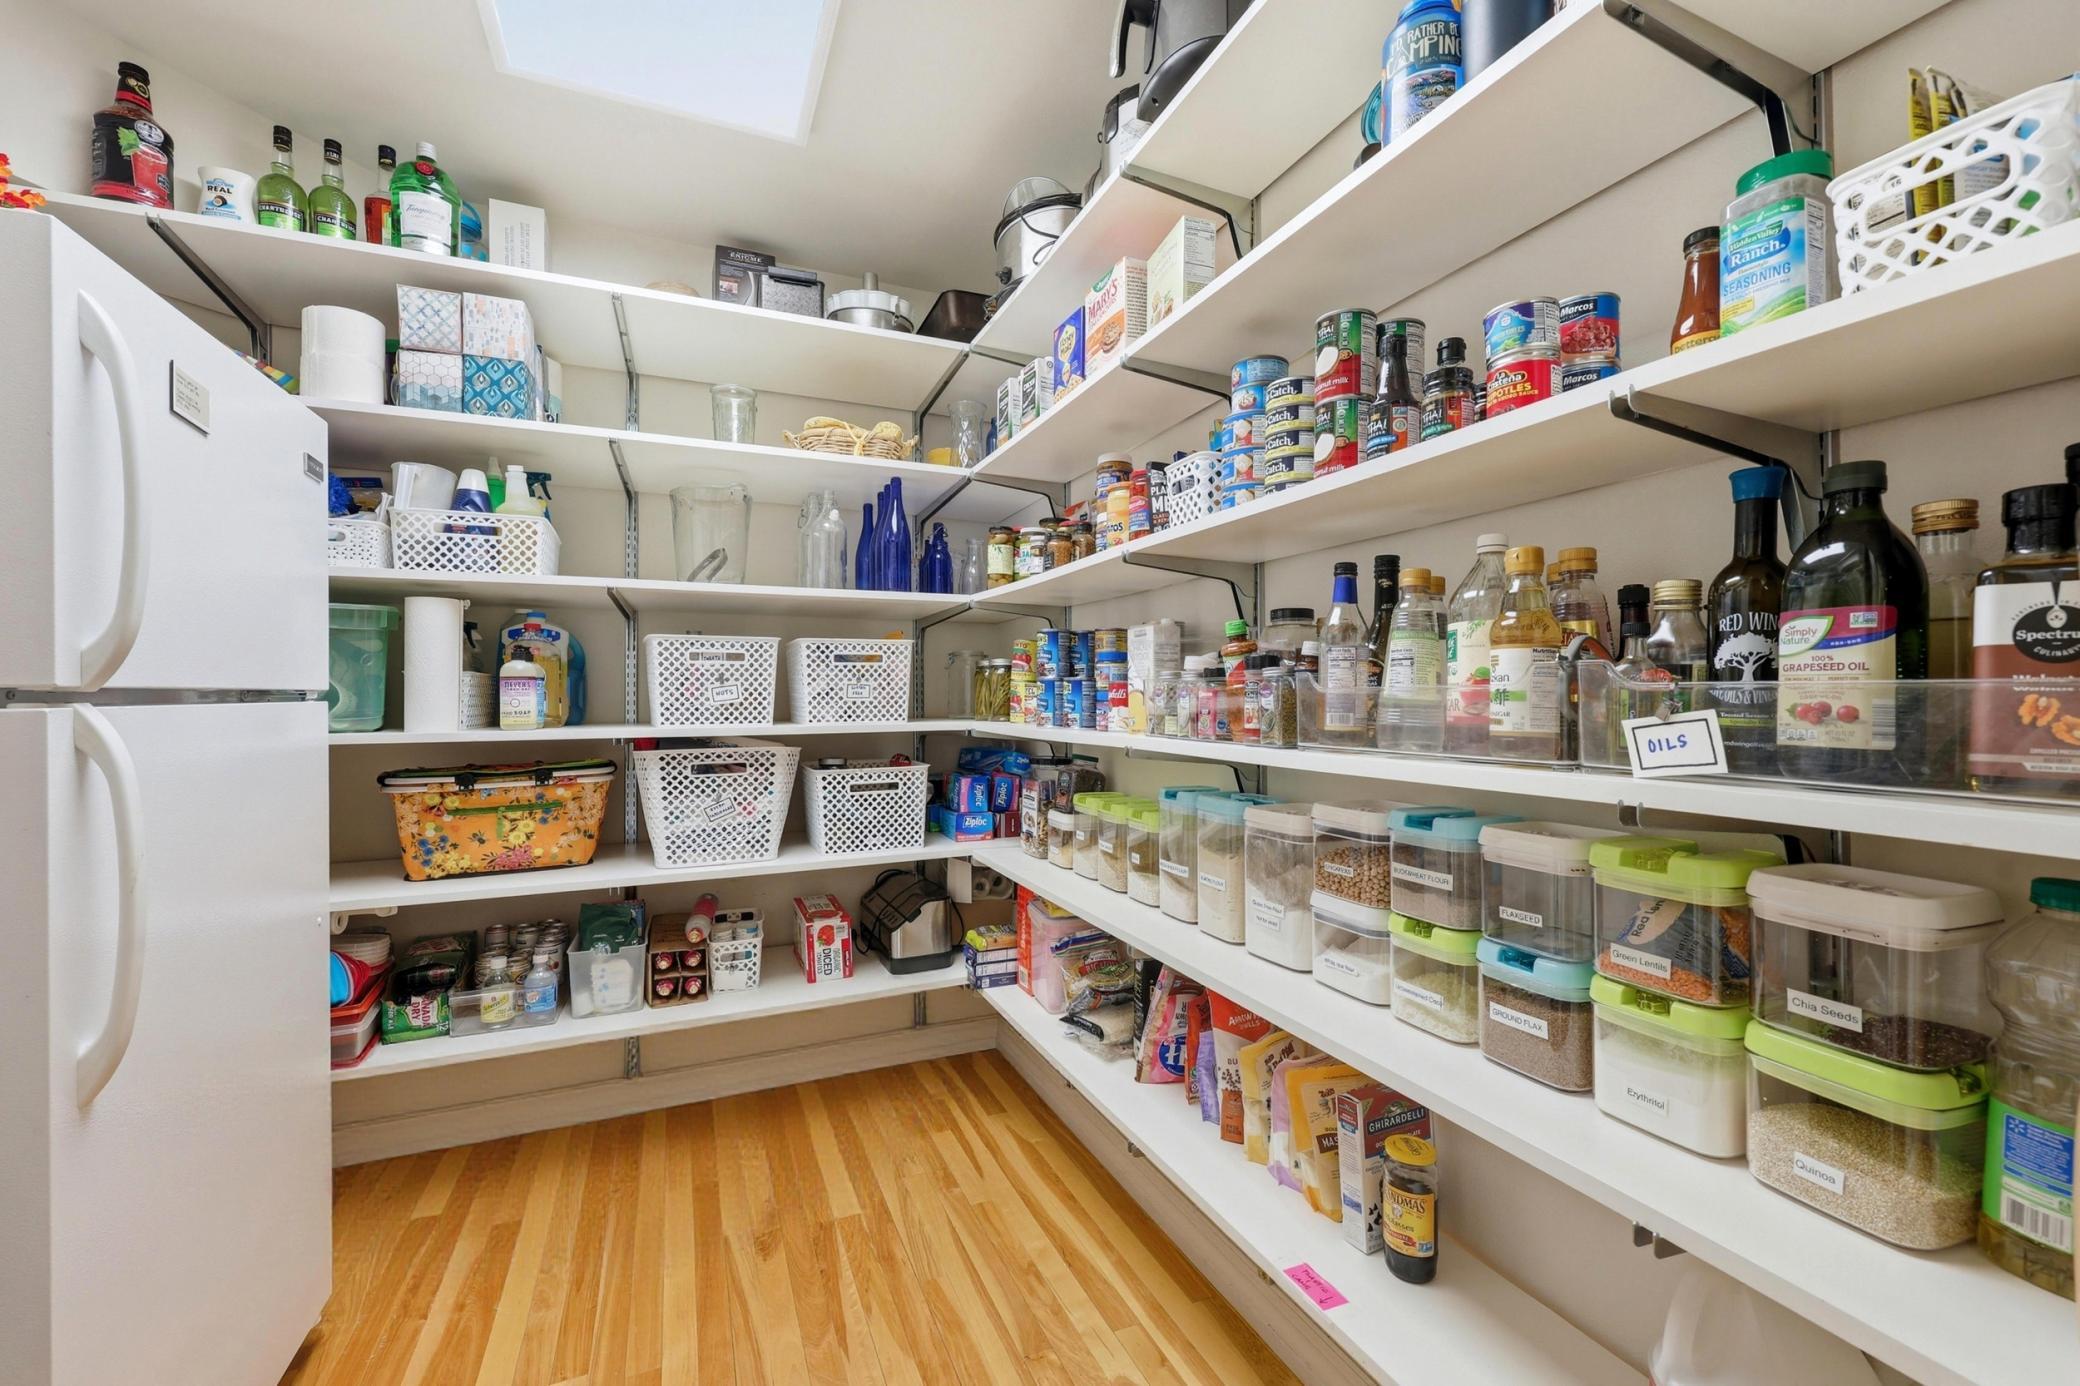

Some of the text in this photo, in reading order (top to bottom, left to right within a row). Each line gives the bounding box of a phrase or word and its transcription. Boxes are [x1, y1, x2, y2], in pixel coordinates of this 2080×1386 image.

[1407, 21, 1445, 45] RATHER
[207, 185, 233, 195] REAL
[1723, 261, 1792, 297] SEASONING
[1560, 301, 1594, 318] Marcos
[1563, 372, 1598, 386] Marcos
[1719, 611, 1779, 632] RED WIN
[1785, 626, 1818, 638] Simply
[2015, 629, 2080, 642] Spectru
[1782, 662, 1870, 673] GRAPESEED OIL
[1647, 734, 1688, 753] OILS
[974, 783, 985, 807] Ziploc
[965, 816, 988, 827] Ziploc
[1394, 867, 1449, 886] BUCKWHEAT FLOUR
[1501, 908, 1540, 925] FLAXSEED
[822, 947, 833, 976] DICED
[1612, 949, 1668, 973] Green Lentils
[411, 1001, 421, 1022] DRY
[1492, 1008, 1543, 1032] GROUND FLAX
[1791, 995, 1859, 1026] Chia Seeds
[1368, 1107, 1425, 1133] GHIRARDELLI
[1795, 1158, 1836, 1185] Quinoa
